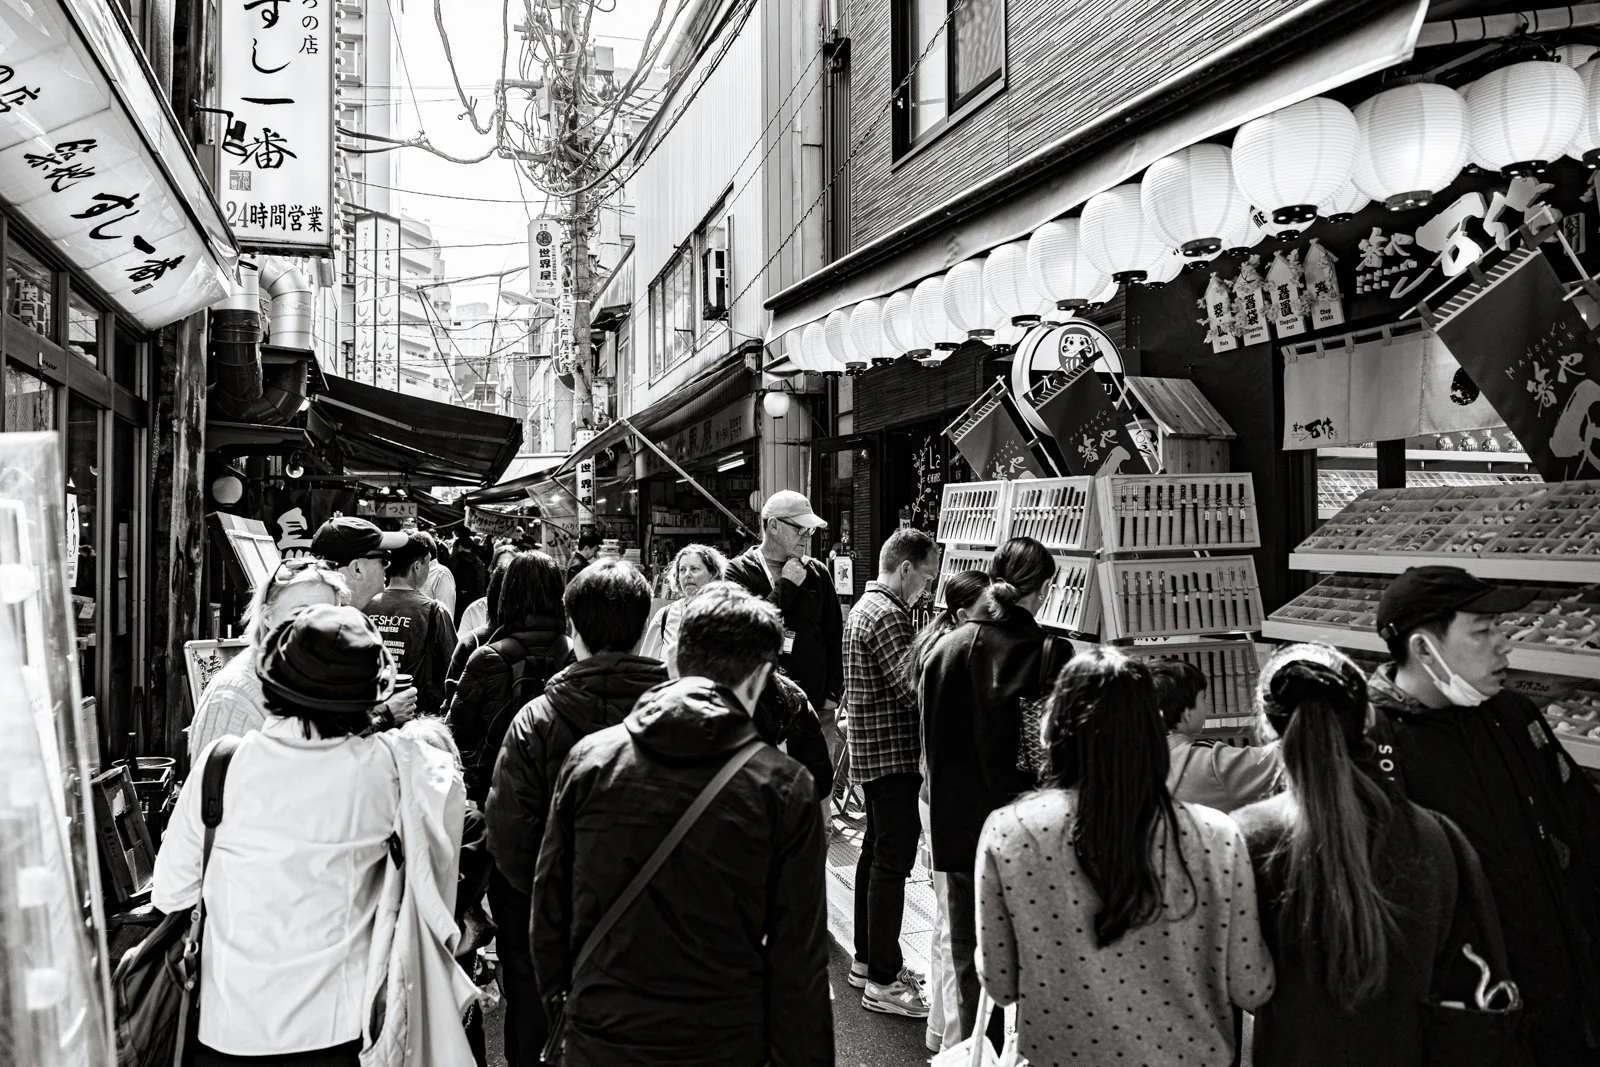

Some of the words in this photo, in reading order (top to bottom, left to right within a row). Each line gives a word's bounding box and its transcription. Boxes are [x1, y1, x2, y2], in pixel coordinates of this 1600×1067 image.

[239, 0, 298, 169] すし一番
[226, 200, 325, 233] 24時間営業
[538, 248, 552, 281] 世界屋
[1504, 321, 1566, 380] MANSAKU
[387, 504, 416, 516] つきじ
